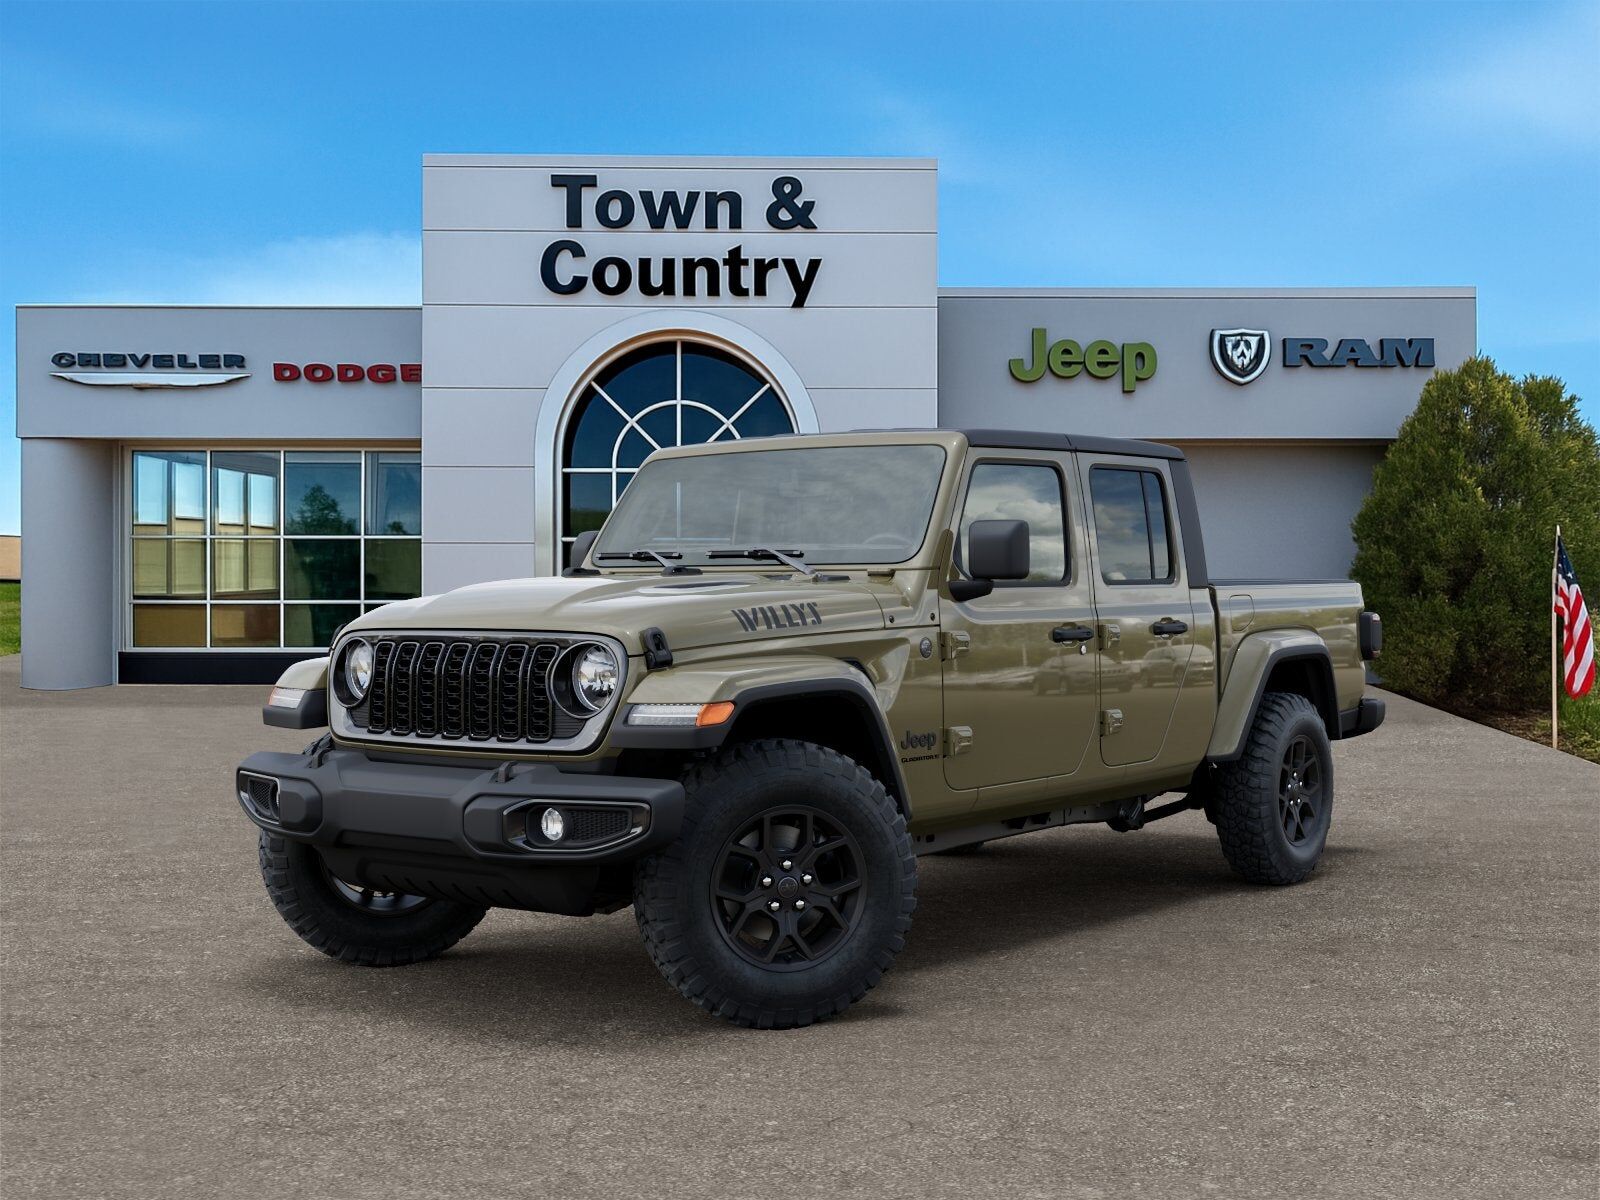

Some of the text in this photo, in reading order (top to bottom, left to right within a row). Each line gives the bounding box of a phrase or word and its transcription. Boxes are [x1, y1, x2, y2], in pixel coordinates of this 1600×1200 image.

[550, 174, 818, 230] Town &
[540, 239, 822, 308] Country
[1009, 327, 1158, 393] Jeep
[1282, 338, 1435, 368] RAM
[273, 363, 422, 383] DODGE
[731, 602, 822, 632] WILLYS
[901, 730, 937, 750] Jeep
